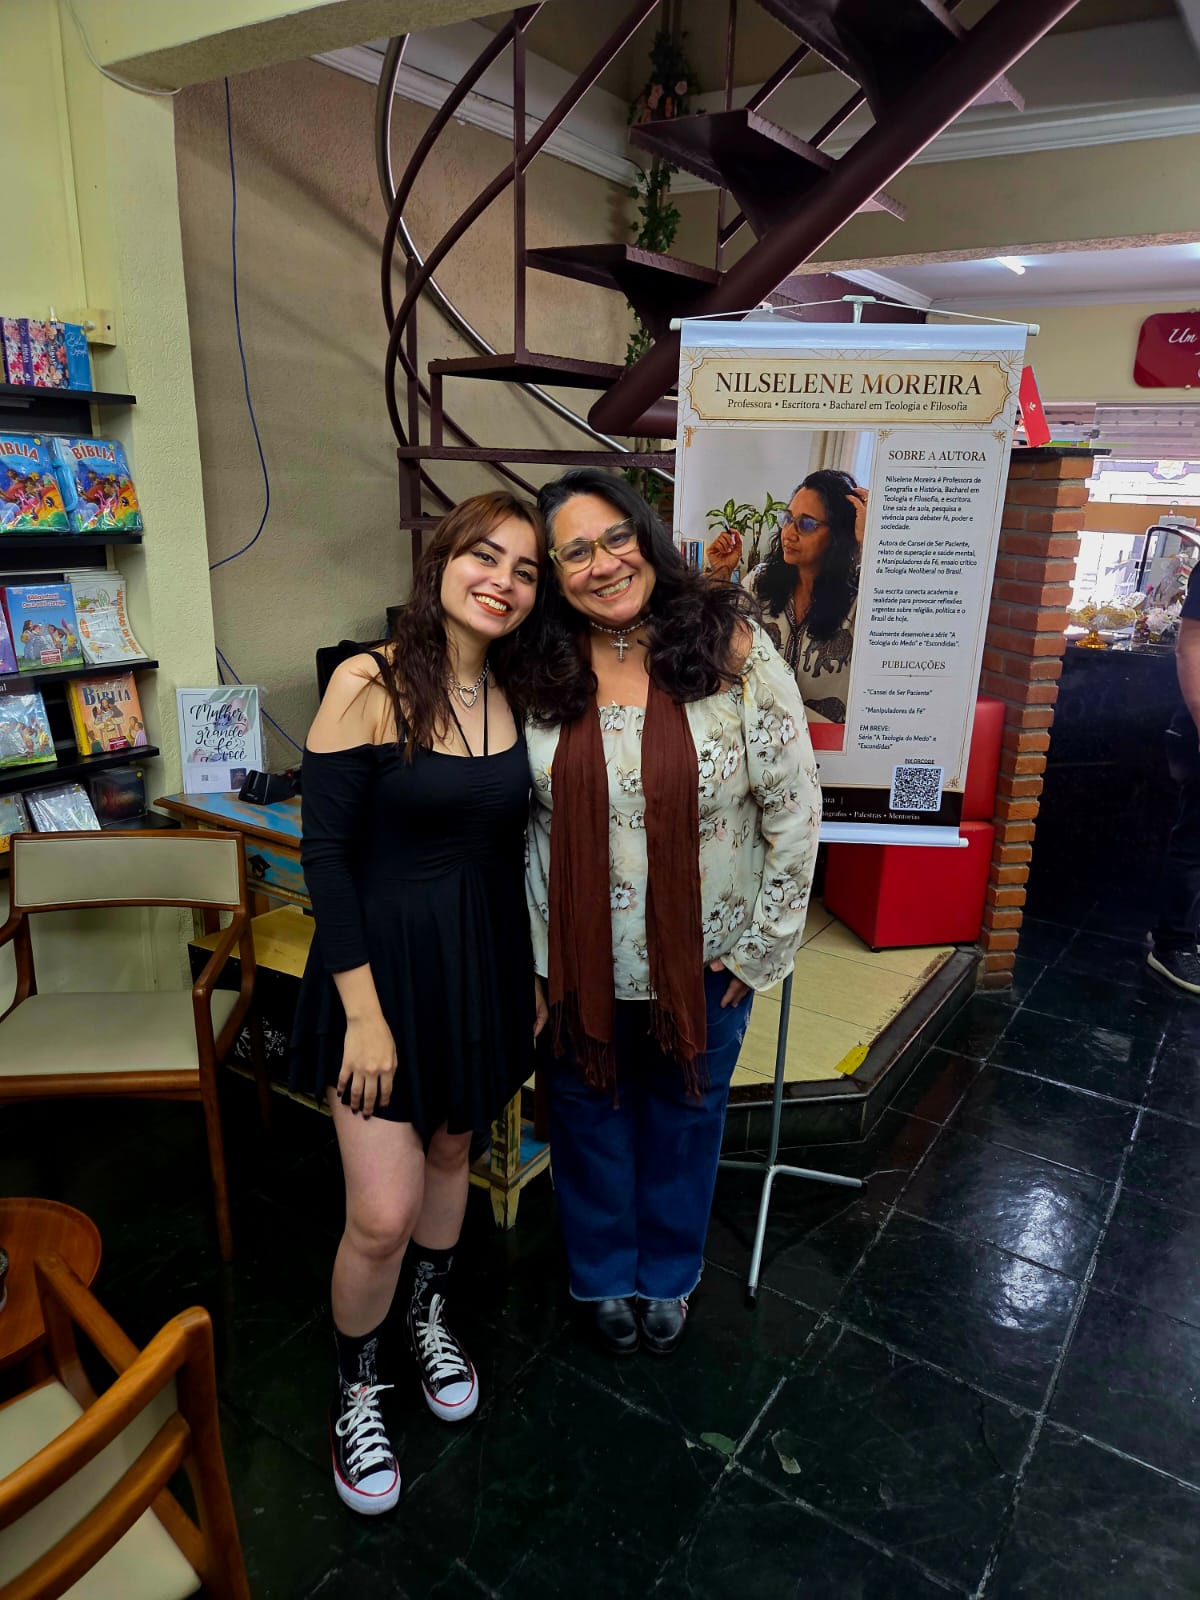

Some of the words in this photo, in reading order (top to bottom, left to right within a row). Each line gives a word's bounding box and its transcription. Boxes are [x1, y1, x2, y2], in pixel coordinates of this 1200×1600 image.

[1168, 327, 1197, 343] Um
[715, 372, 853, 394] NILSELENE
[860, 373, 982, 396] MOREIRA
[727, 398, 772, 410] Professora
[781, 399, 820, 410] Escritora
[829, 400, 867, 412] Bacharel
[869, 402, 882, 411] em
[885, 401, 921, 413] Teologia
[930, 402, 968, 412] Filosofia
[888, 450, 925, 460] SOBRE
[928, 451, 936, 460] A
[939, 451, 986, 461] AUTORA
[884, 495, 907, 503] Teologia
[873, 587, 884, 595] Sua
[882, 660, 946, 671] PUBLICAÇÕES
[195, 726, 243, 745] grande
[854, 811, 882, 820] Palestras
[888, 813, 921, 821] Mentorias
